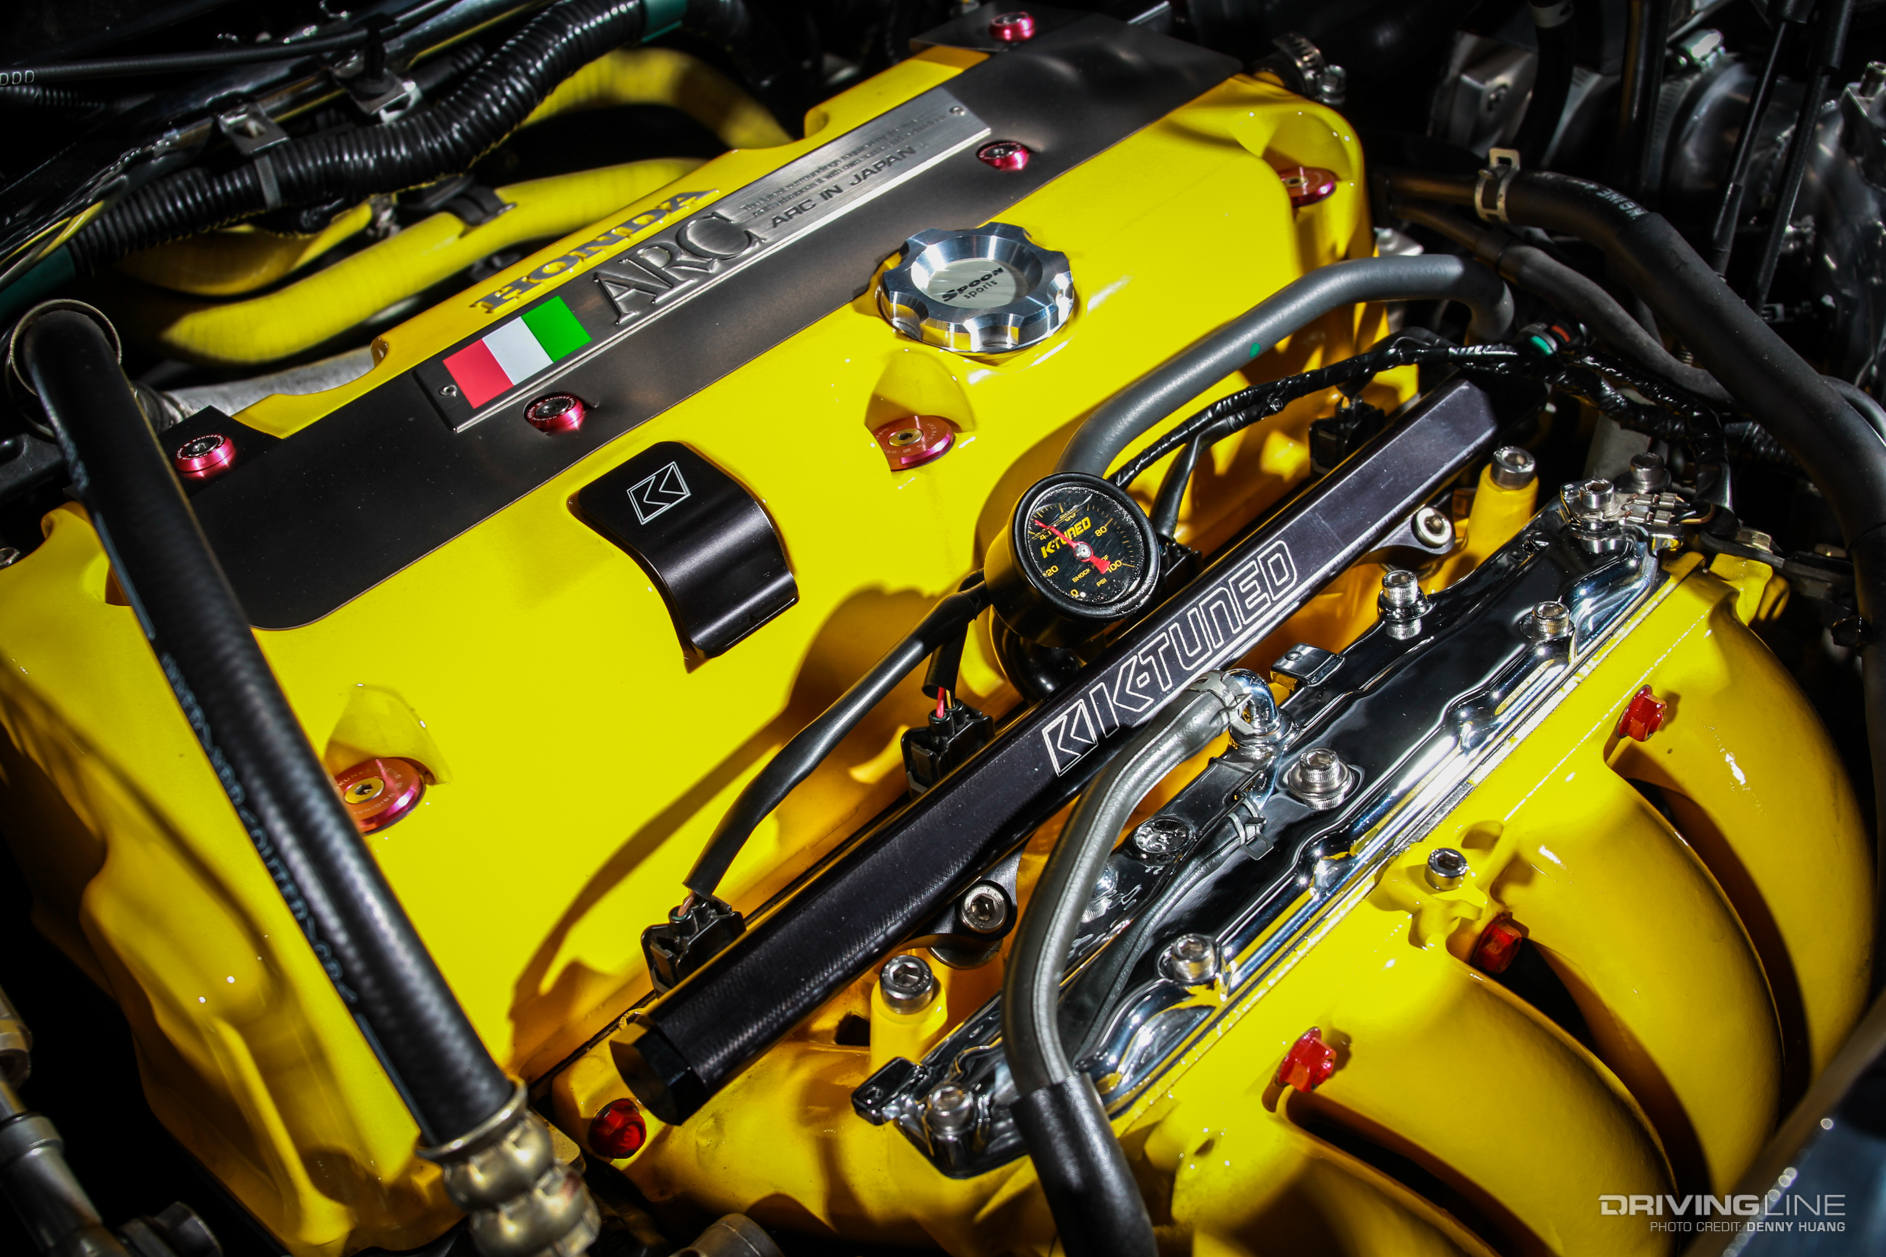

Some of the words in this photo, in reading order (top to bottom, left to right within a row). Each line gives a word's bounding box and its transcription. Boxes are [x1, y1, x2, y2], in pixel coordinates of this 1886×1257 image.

[771, 198, 817, 229] ARC
[819, 183, 844, 201] IN
[849, 145, 917, 187] JAPAN
[469, 188, 720, 315] HONDA
[593, 211, 767, 326] ARC
[963, 280, 998, 299] sports
[1094, 525, 1108, 538] 80
[1046, 565, 1059, 577] 20
[1106, 559, 1123, 573] 100
[1071, 568, 1091, 583] SHOCK
